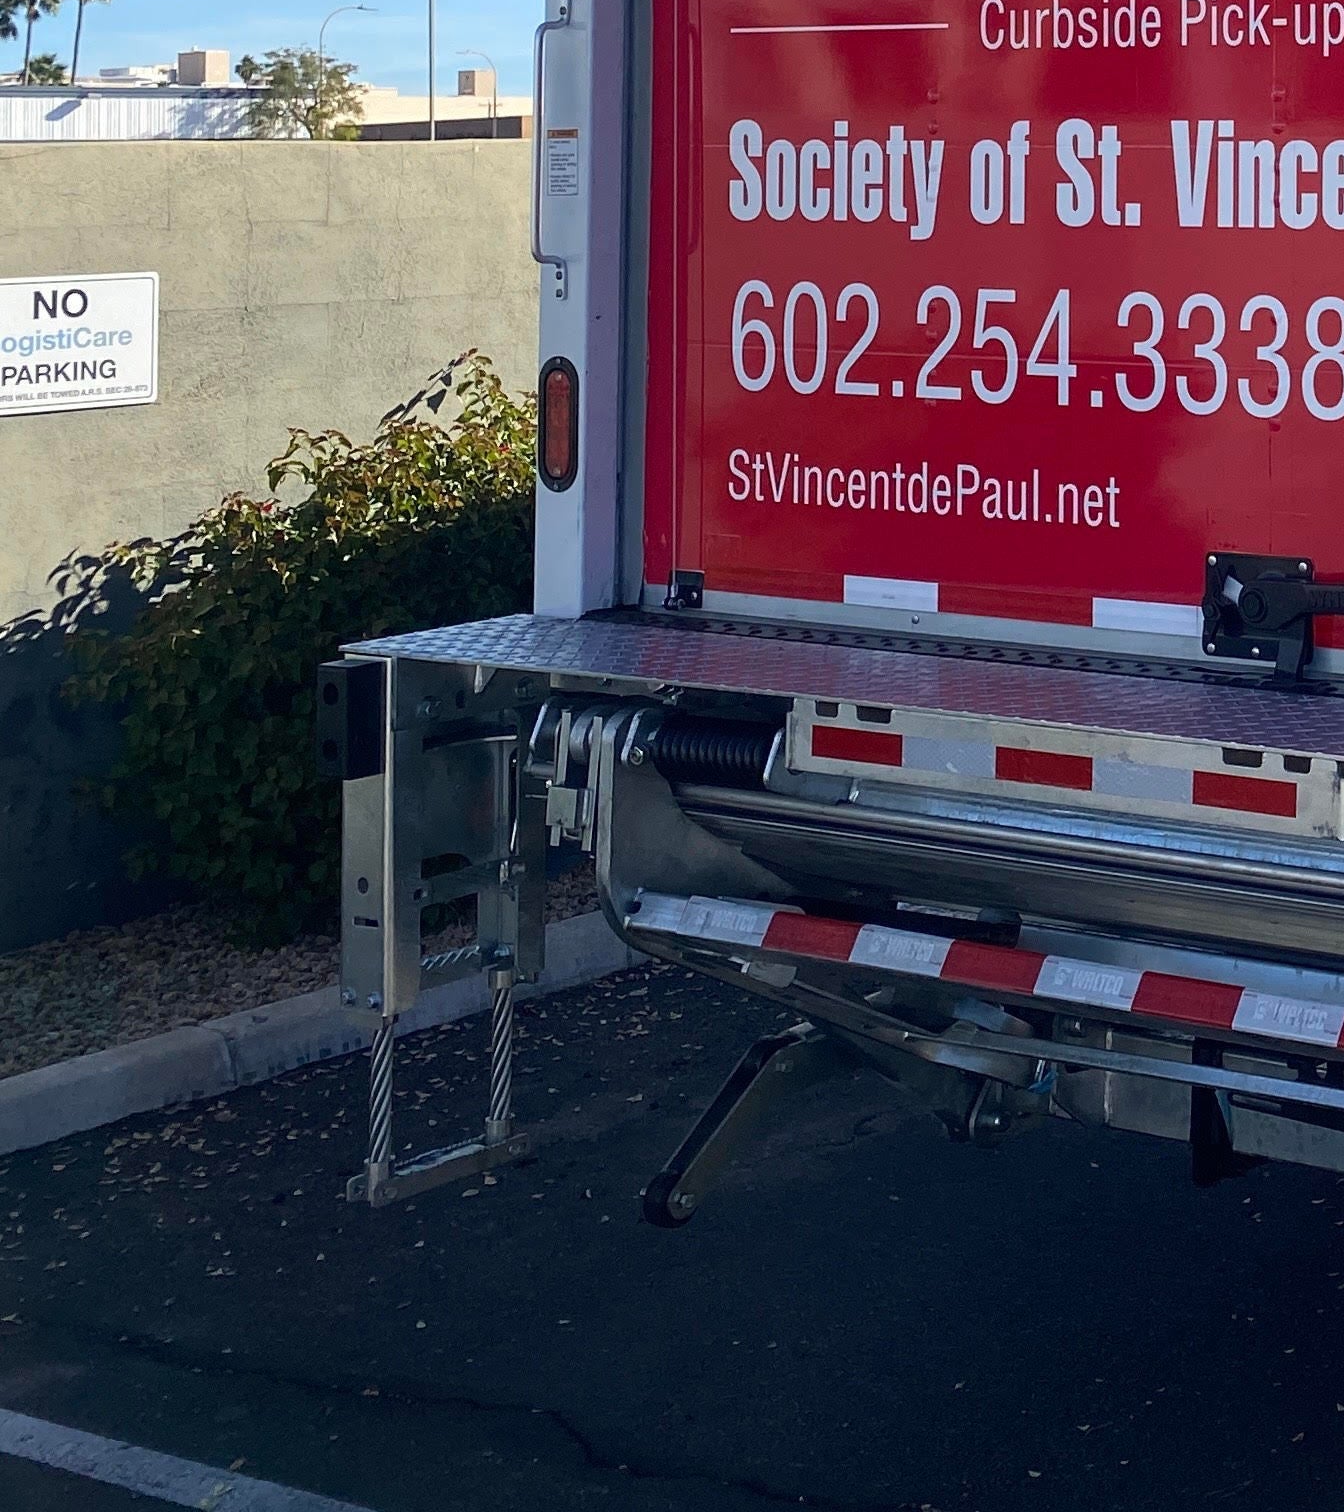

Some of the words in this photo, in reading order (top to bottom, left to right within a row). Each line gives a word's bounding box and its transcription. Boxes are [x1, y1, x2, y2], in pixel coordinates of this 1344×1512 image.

[730, 120, 944, 240] Society
[971, 121, 1029, 224] of
[1056, 119, 1140, 227] St.
[33, 289, 88, 320] NO
[0, 327, 133, 357] ogistiCare
[1, 359, 117, 387] PARKING
[729, 449, 1119, 527] StVincentdePaul.net
